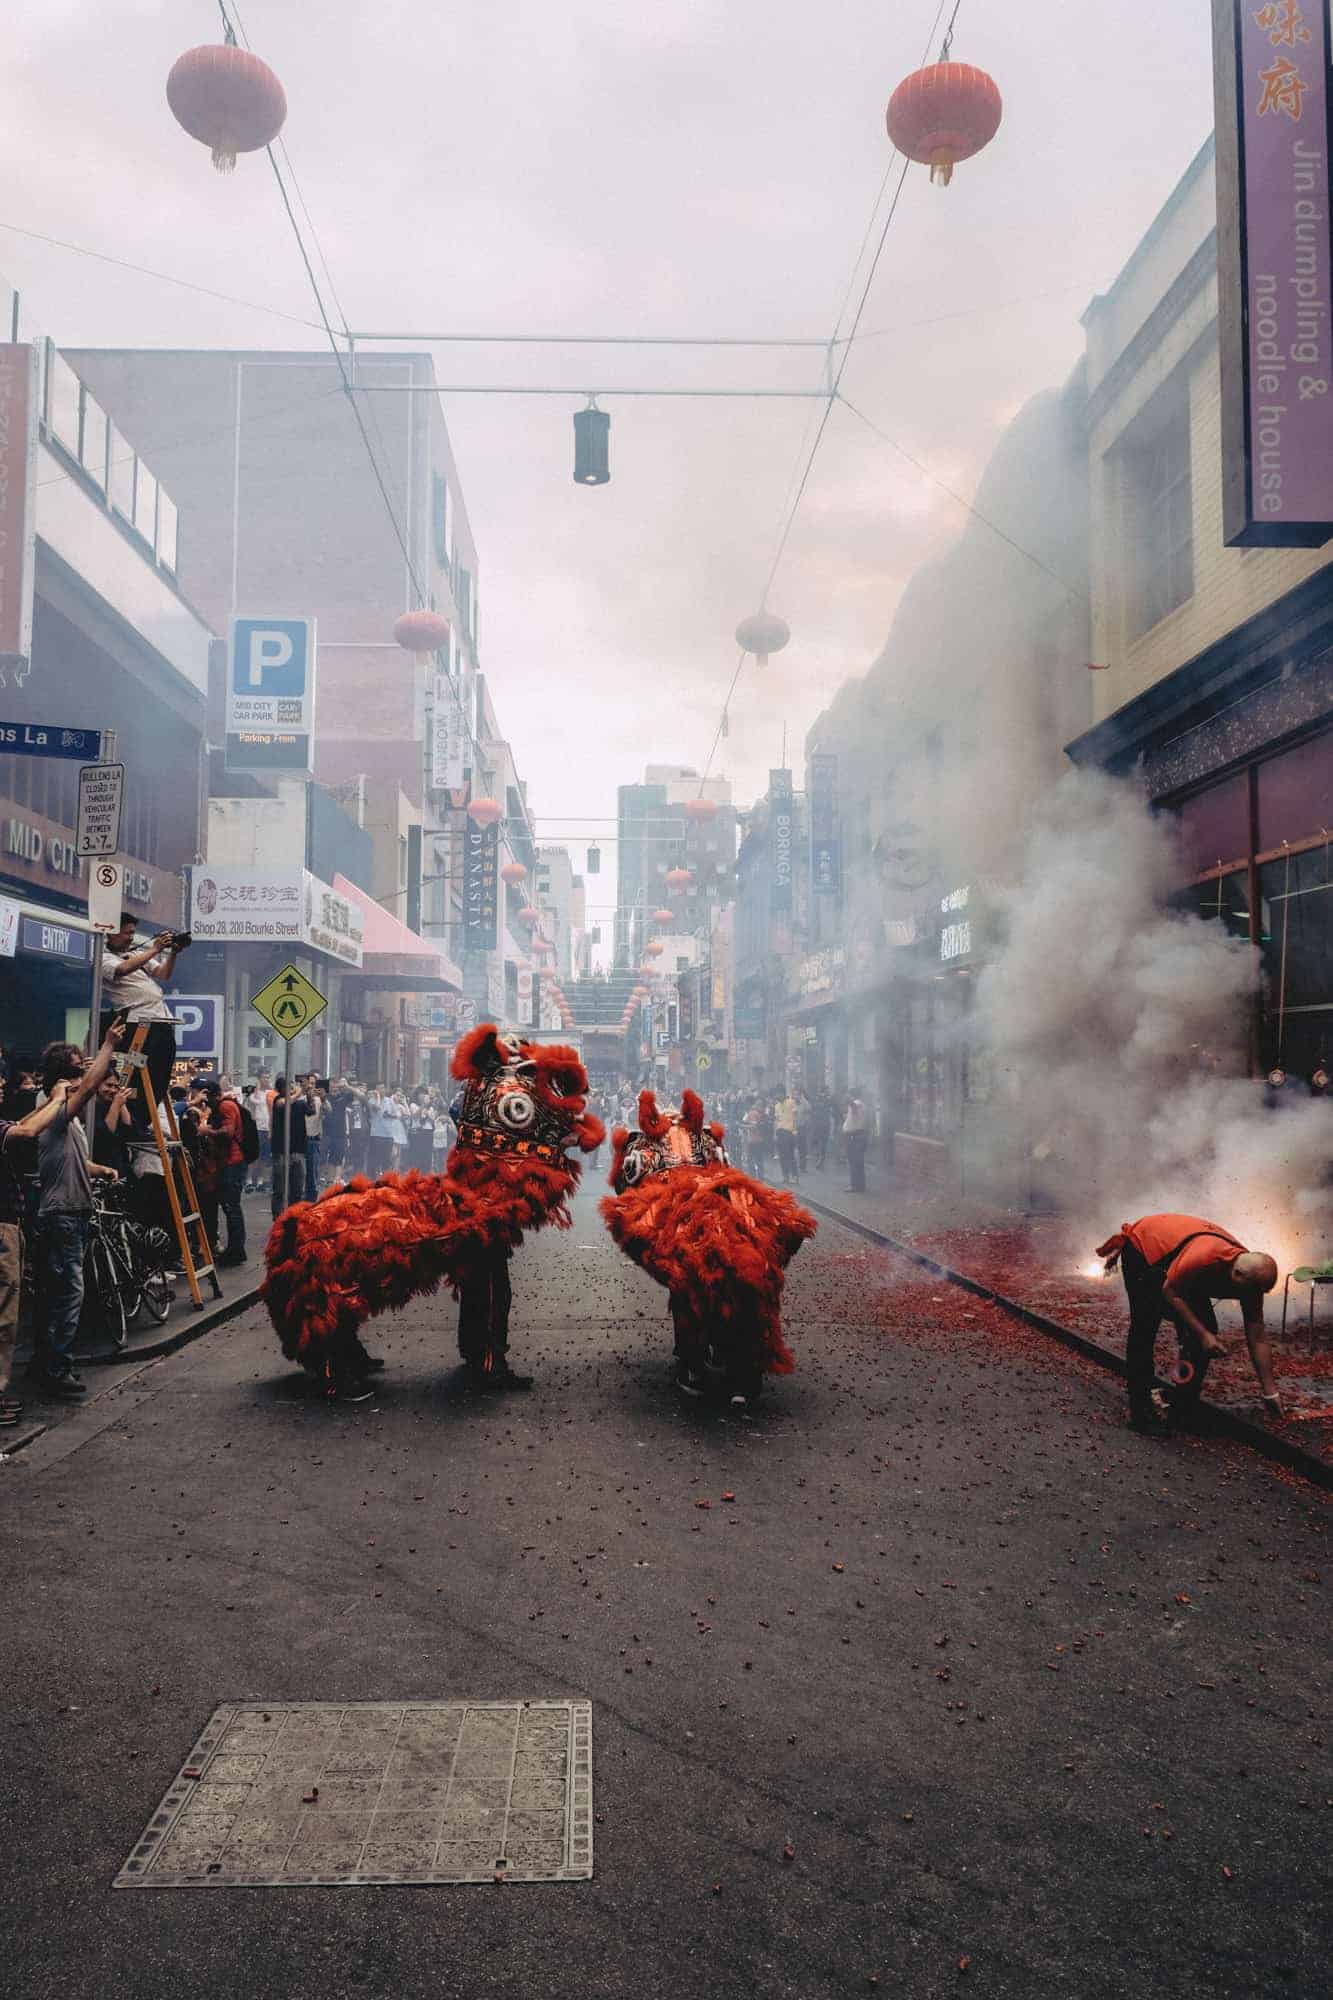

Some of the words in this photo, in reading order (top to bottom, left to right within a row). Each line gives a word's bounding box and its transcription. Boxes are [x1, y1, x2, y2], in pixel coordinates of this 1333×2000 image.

[1293, 140, 1322, 191] Jin
[1289, 199, 1326, 363] dumpling
[1255, 274, 1286, 393] noodle
[1298, 375, 1328, 401] &
[1258, 405, 1287, 513] house
[249, 630, 293, 685] P
[24, 726, 48, 744] La
[233, 711, 250, 720] CAR
[252, 711, 273, 721] PARK
[9, 819, 42, 862] MID
[776, 815, 792, 888] BORNGA
[469, 833, 482, 928] DYNASTY
[41, 925, 71, 954] ENTRY
[194, 920, 216, 937] Shop
[230, 920, 244, 935] 200
[246, 920, 273, 936] Bourke
[275, 921, 299, 936] Street
[175, 1005, 204, 1046] P
